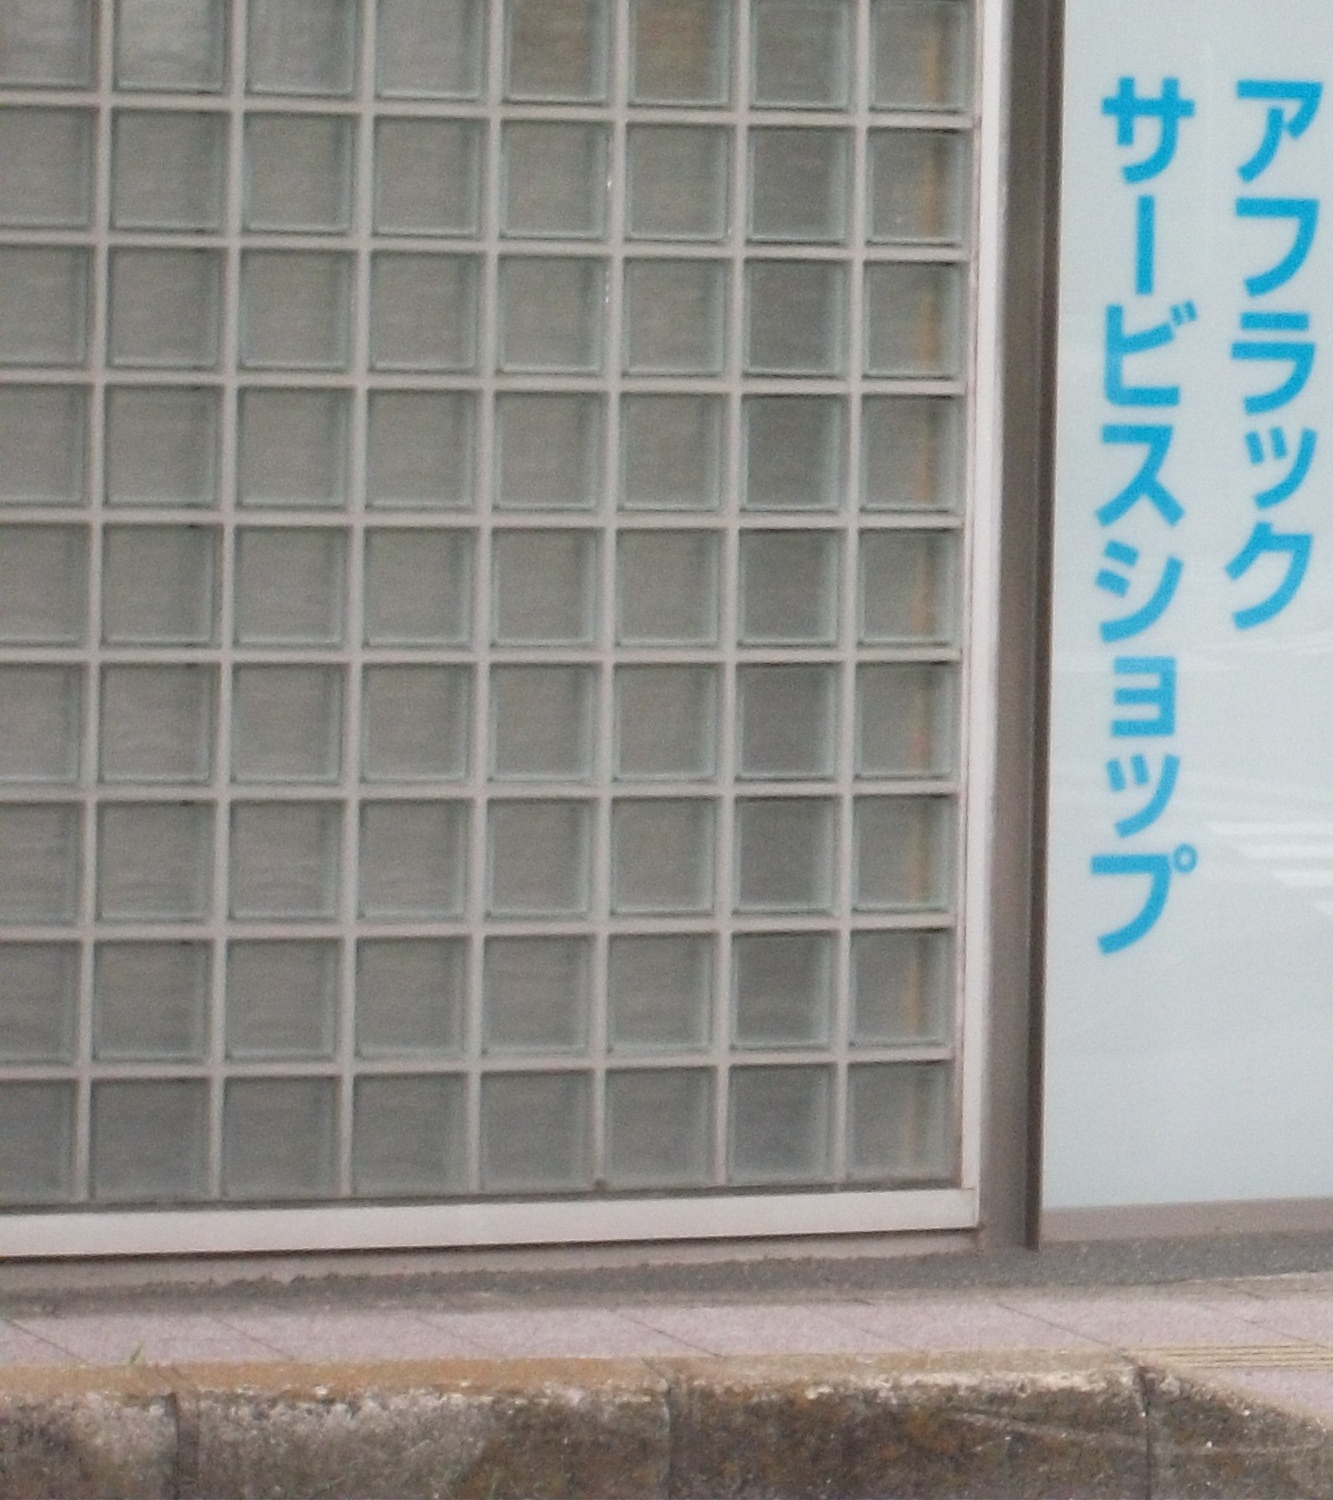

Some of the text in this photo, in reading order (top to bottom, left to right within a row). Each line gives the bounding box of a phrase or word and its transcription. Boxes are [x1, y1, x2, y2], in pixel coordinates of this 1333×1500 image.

[1091, 76, 1199, 955] サービスショップ
[1225, 79, 1324, 630] アフラック
